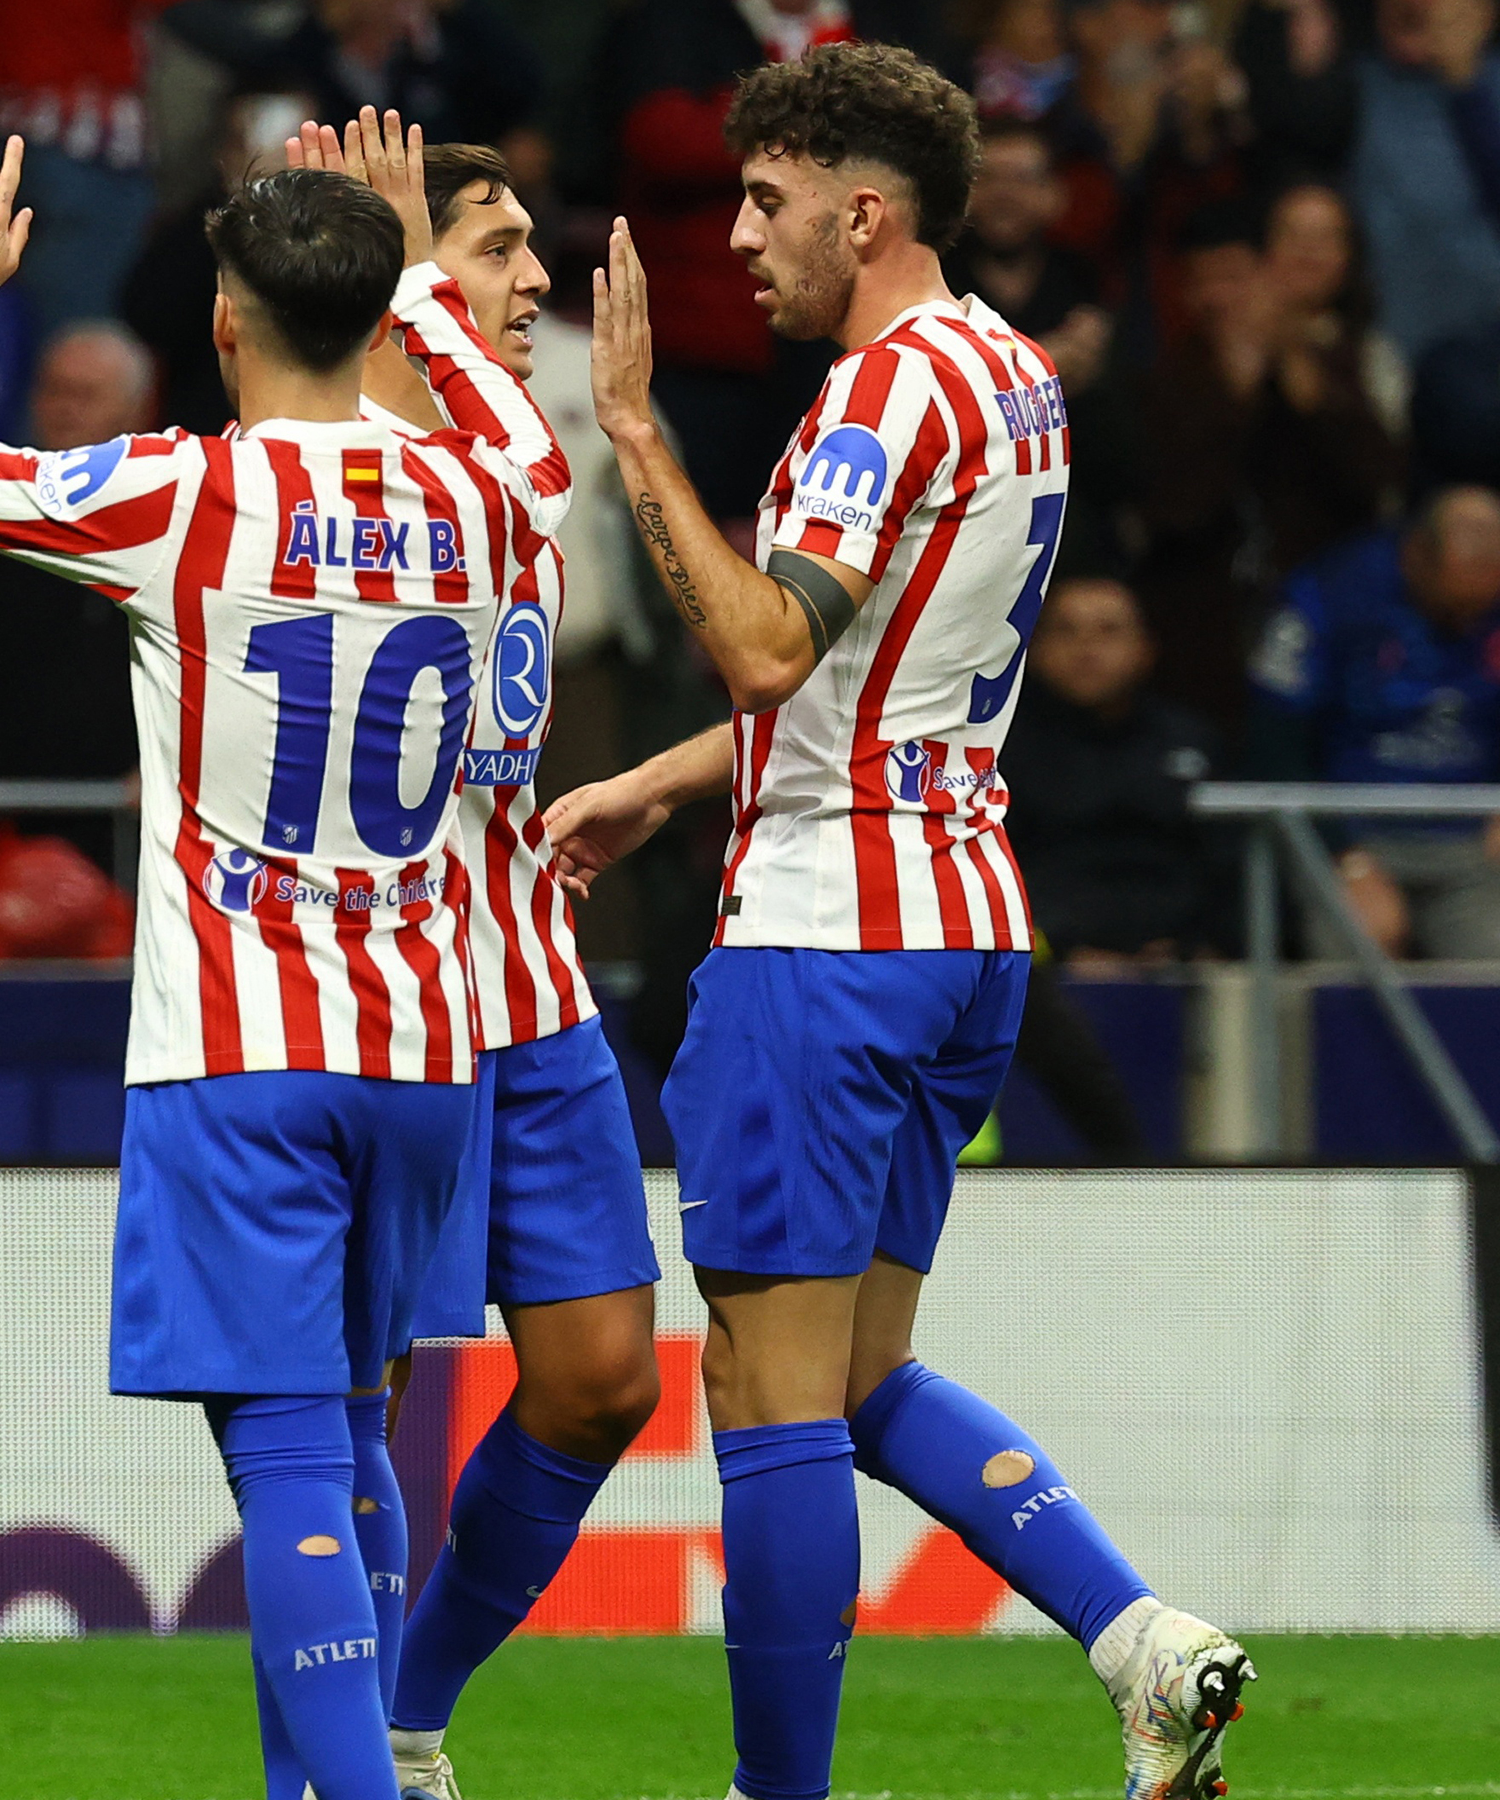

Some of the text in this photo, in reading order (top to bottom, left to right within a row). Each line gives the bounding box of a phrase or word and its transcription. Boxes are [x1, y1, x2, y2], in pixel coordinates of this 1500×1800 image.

[283, 500, 468, 573] ÁLEX B.
[797, 494, 873, 531] kraken
[637, 492, 707, 628] Carpe Diem
[966, 492, 1066, 723] 3
[242, 613, 475, 858] 10
[933, 766, 977, 792] Save
[276, 875, 446, 911] Save the Childre
[294, 1638, 376, 1671] ATLETI
